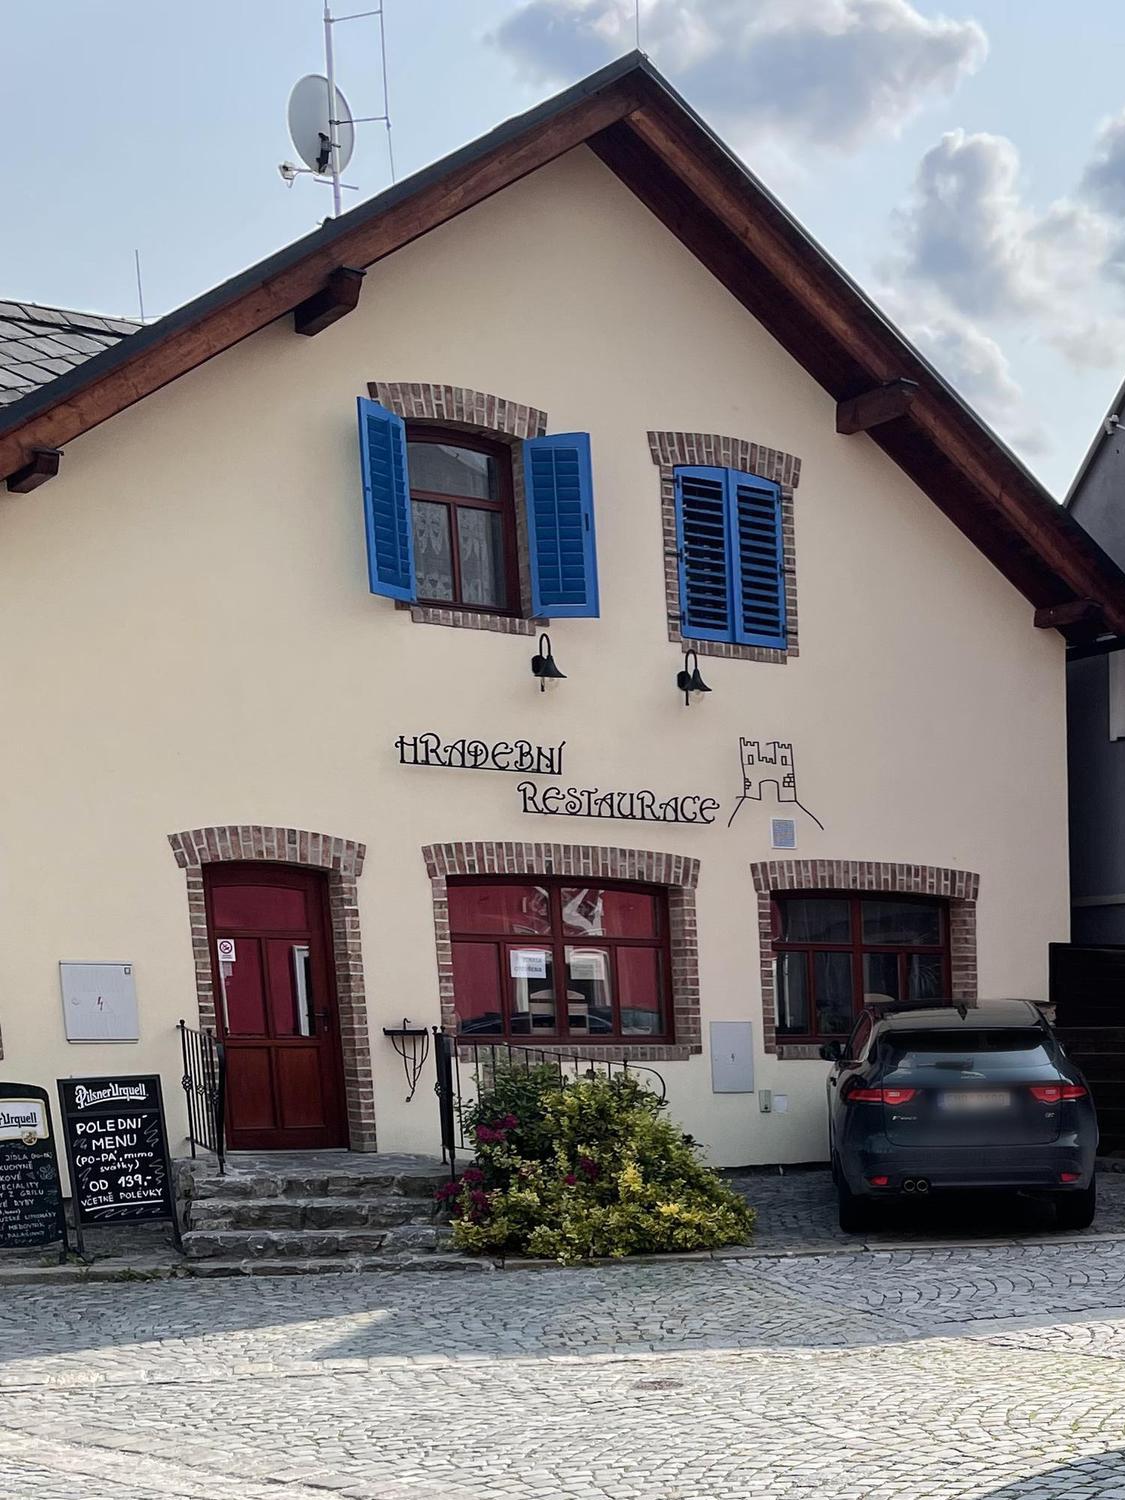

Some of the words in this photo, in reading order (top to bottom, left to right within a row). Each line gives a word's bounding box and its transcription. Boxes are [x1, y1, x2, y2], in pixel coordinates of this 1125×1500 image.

[395, 733, 566, 775] HRADEBNÍ
[517, 781, 720, 824] RESTAURACE
[75, 1085, 112, 1109] Pilsner
[109, 1082, 147, 1101] Urquell
[1, 1112, 37, 1128] Urquell
[76, 1115, 148, 1135] POLEDNÍ
[92, 1134, 137, 1150] MENU
[100, 1160, 140, 1172] svátky)
[89, 1180, 109, 1192] OD
[81, 1192, 114, 1206] VČETNĚ
[120, 1187, 163, 1199] POLÉVKY
